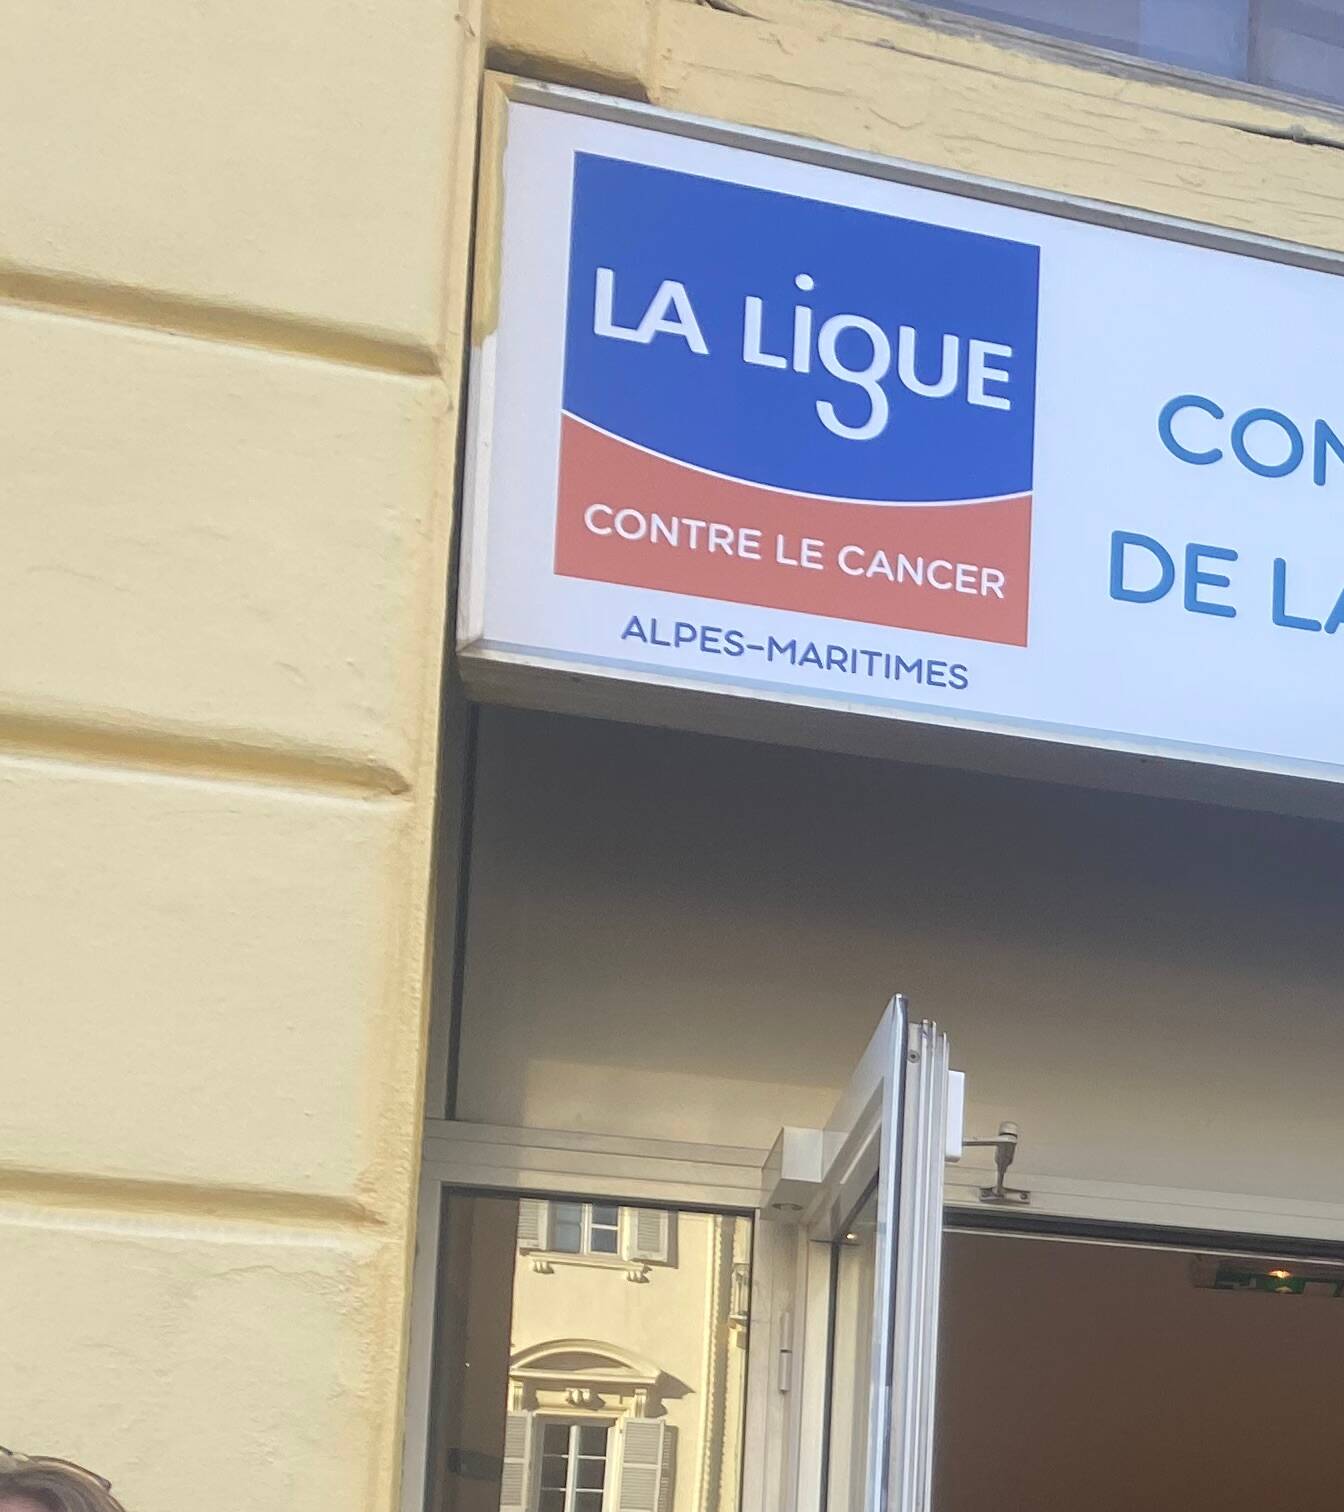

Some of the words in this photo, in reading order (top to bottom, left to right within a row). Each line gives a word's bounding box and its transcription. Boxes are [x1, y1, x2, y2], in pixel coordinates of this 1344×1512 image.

[592, 267, 709, 355] LA
[584, 502, 761, 561] CONTRE
[776, 533, 824, 571] LE
[838, 545, 1006, 600] CANCER
[1110, 530, 1239, 619] DE
[621, 615, 970, 691] ALPES-MARITIMES
